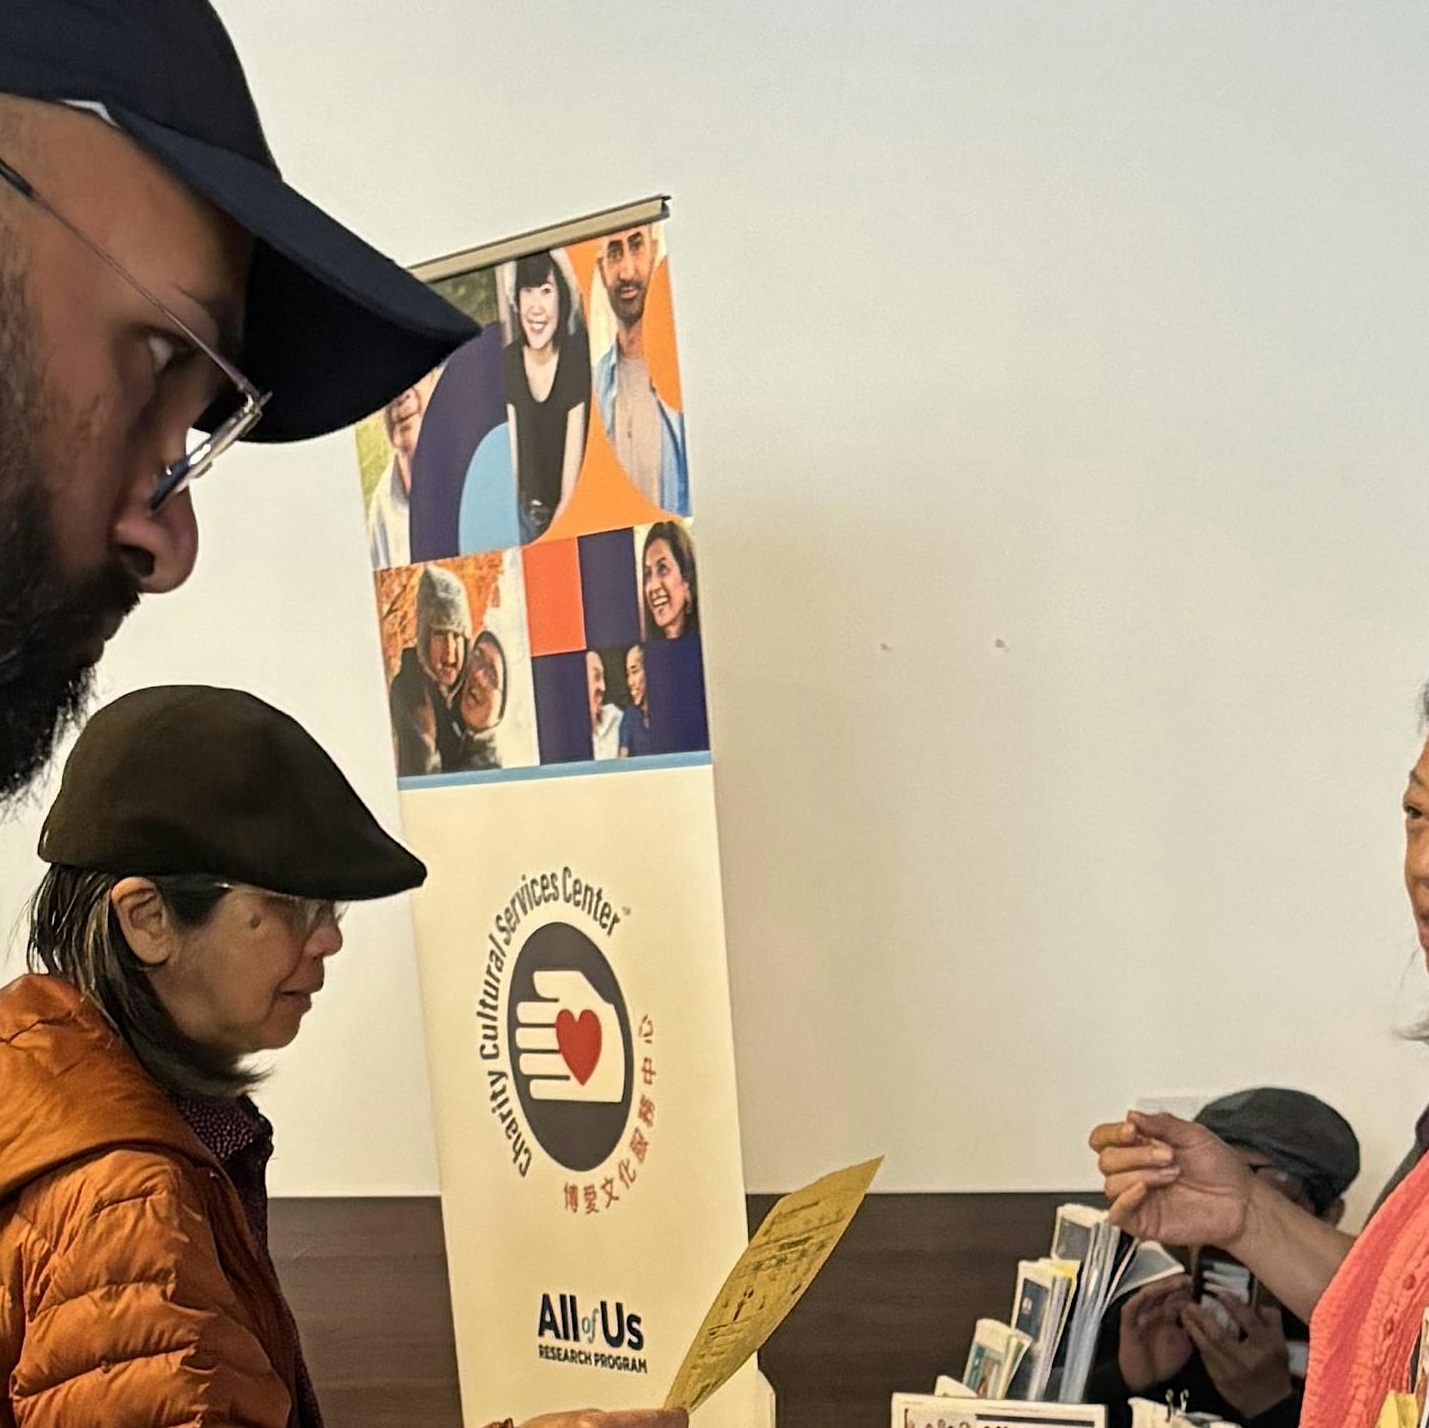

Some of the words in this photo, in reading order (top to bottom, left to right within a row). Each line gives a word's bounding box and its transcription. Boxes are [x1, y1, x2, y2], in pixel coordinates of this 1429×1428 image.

[495, 871, 560, 946] Services
[562, 866, 621, 937] Center
[475, 933, 508, 1061] Cultural
[486, 1069, 532, 1178] Charity
[538, 1293, 580, 1342] All
[581, 1308, 599, 1344] of
[600, 1300, 644, 1351] Us
[538, 1344, 592, 1365] RESEARCH
[594, 1352, 648, 1373] PROGRAM
